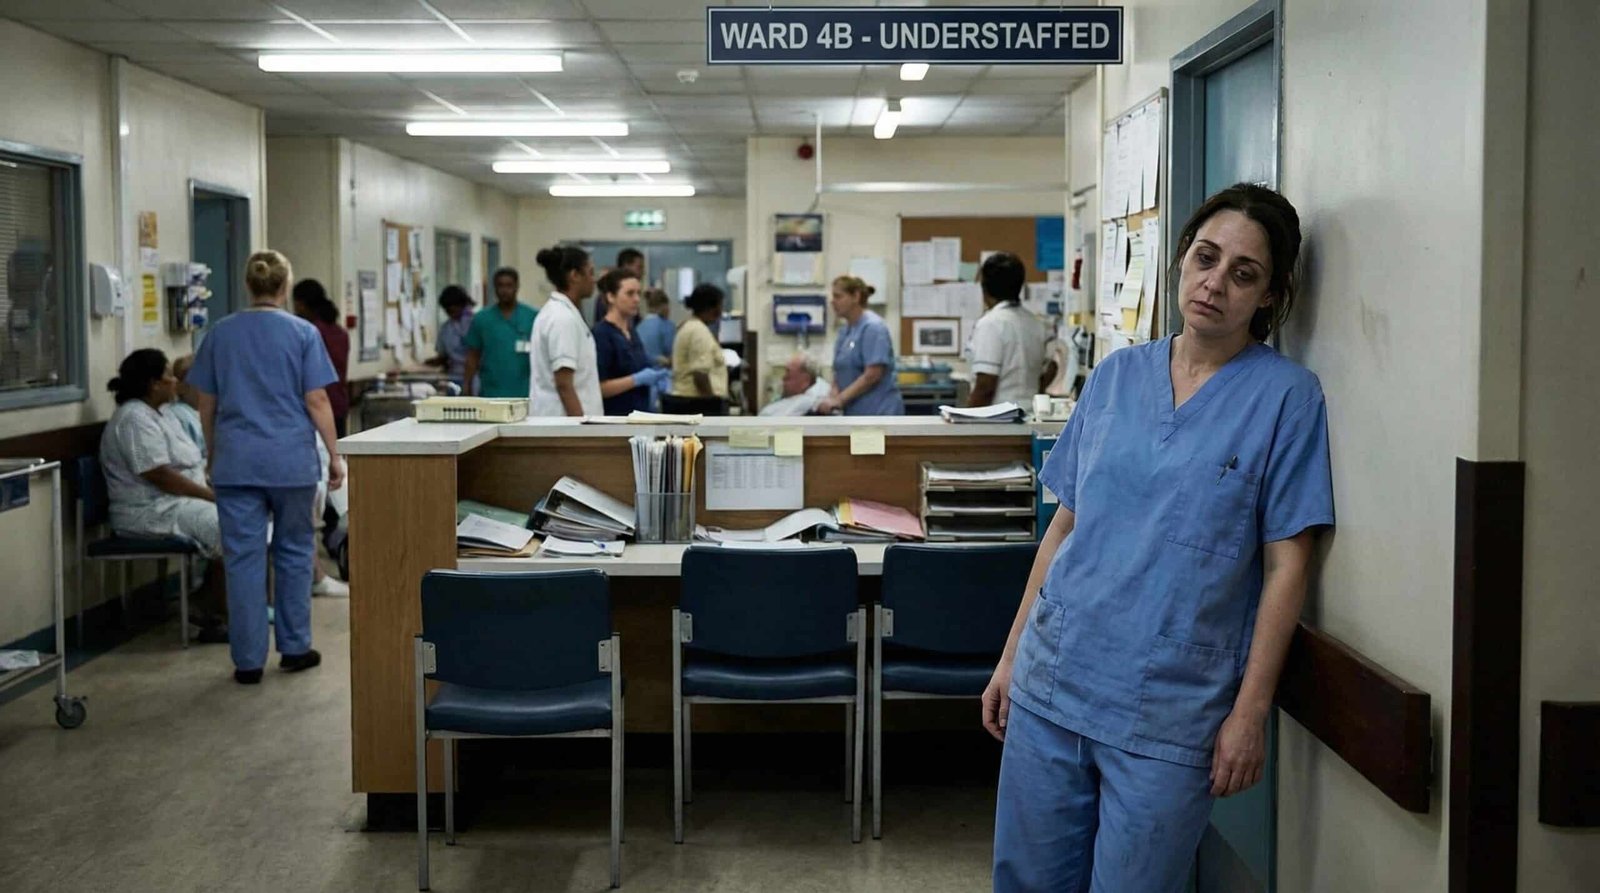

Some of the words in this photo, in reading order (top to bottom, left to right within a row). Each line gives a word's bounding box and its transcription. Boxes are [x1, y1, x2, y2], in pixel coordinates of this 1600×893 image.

[720, 22, 809, 49] WARD
[816, 22, 853, 49] 4B
[861, 35, 872, 43] -
[879, 22, 1110, 50] UNDERSTAFFED
